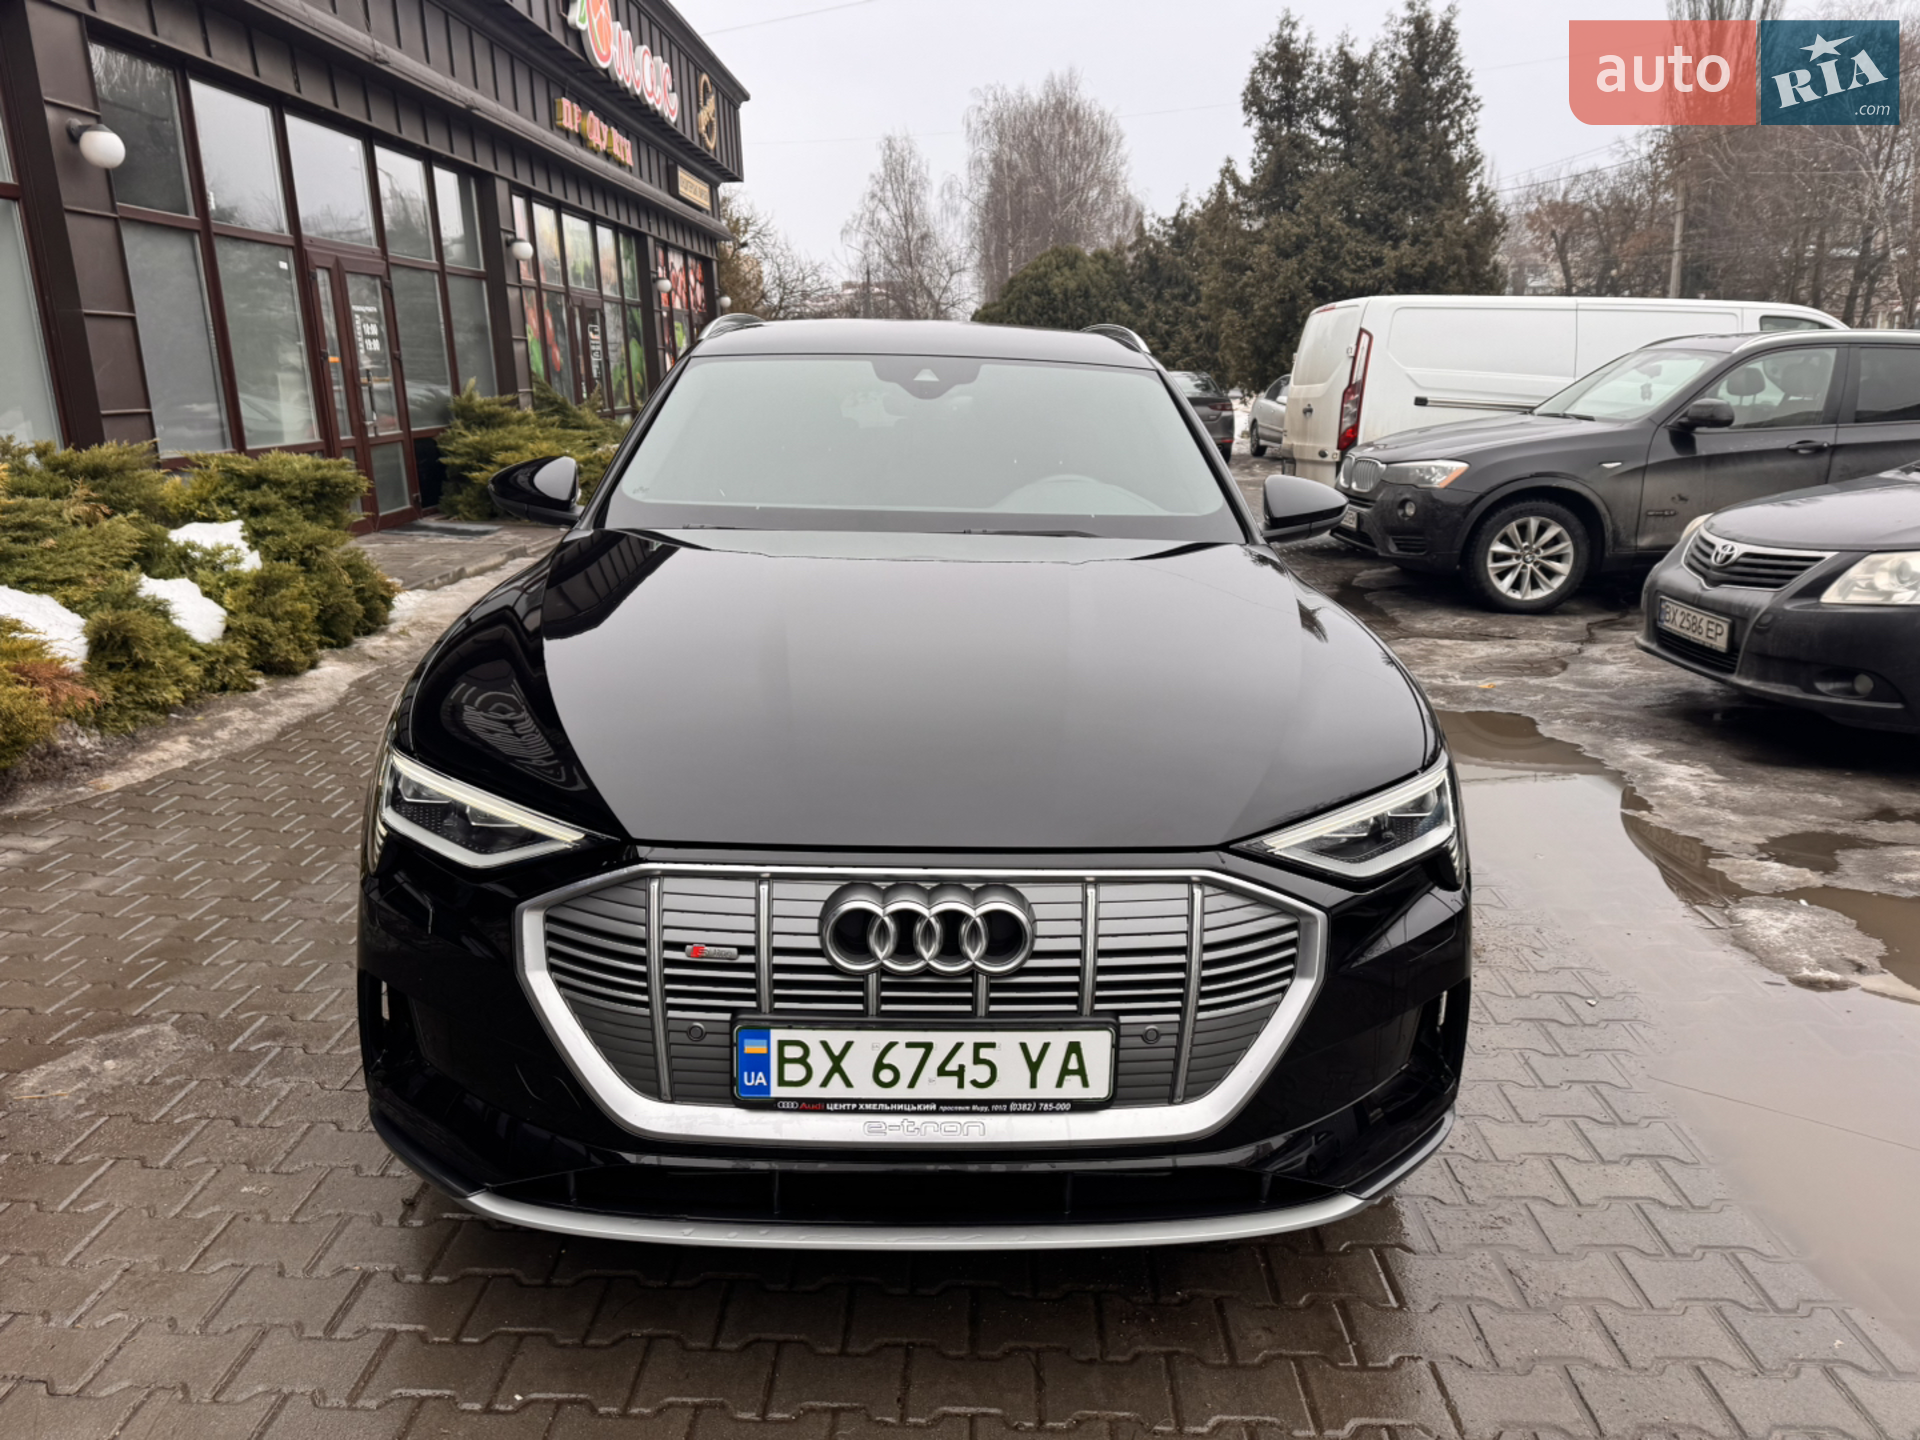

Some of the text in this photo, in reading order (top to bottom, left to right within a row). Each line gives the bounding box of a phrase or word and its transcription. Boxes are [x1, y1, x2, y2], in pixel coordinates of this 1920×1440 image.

[557, 97, 634, 166] ПРОДУКТИ
[1679, 610, 1704, 636] 2586
[1706, 619, 1725, 640] EP
[777, 1039, 1090, 1089] BX 6745 YA
[743, 1071, 768, 1087] UA
[799, 1102, 825, 1111] Audi
[826, 1103, 858, 1112] ЦЕНТР
[858, 1102, 937, 1112] ХМЕЛЬНИЦЬКИЙ
[1010, 1101, 1036, 1112] (0382)
[1039, 1102, 1072, 1111] 785-000
[863, 1118, 985, 1136] e-tron
